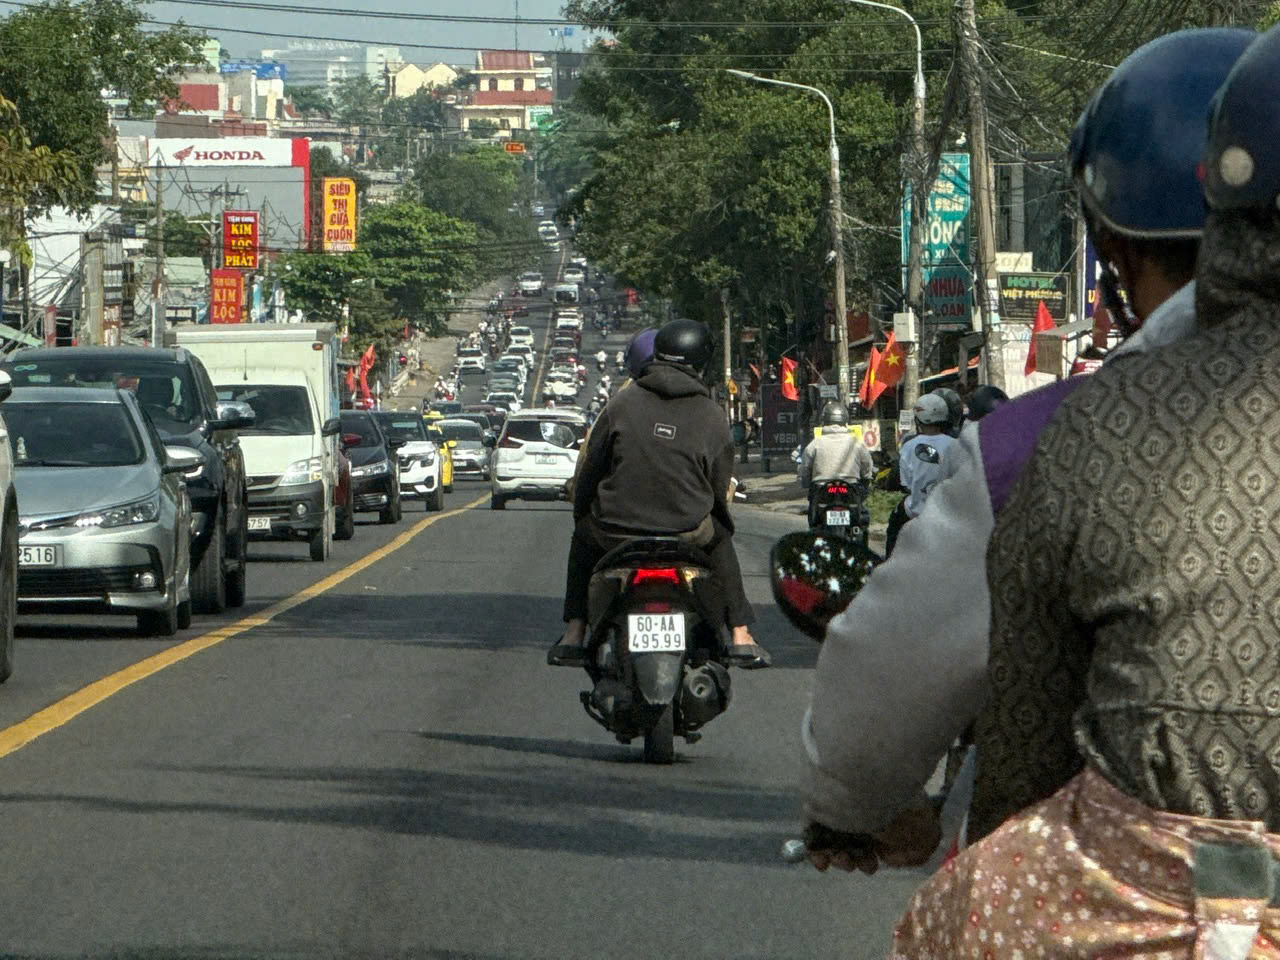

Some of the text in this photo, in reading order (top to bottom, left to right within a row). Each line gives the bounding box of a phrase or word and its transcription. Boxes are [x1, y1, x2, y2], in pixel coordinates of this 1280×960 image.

[194, 150, 265, 161] HONDA
[329, 181, 351, 196] SIÊU
[231, 223, 253, 235] KIM
[327, 225, 353, 241] CUỐN
[225, 252, 255, 266] PHÁT
[1007, 276, 1057, 289] HOTEL
[214, 288, 237, 302] KIM
[213, 302, 236, 321] LỘC
[636, 616, 676, 632] 60-AA
[632, 633, 681, 649] 495.99
